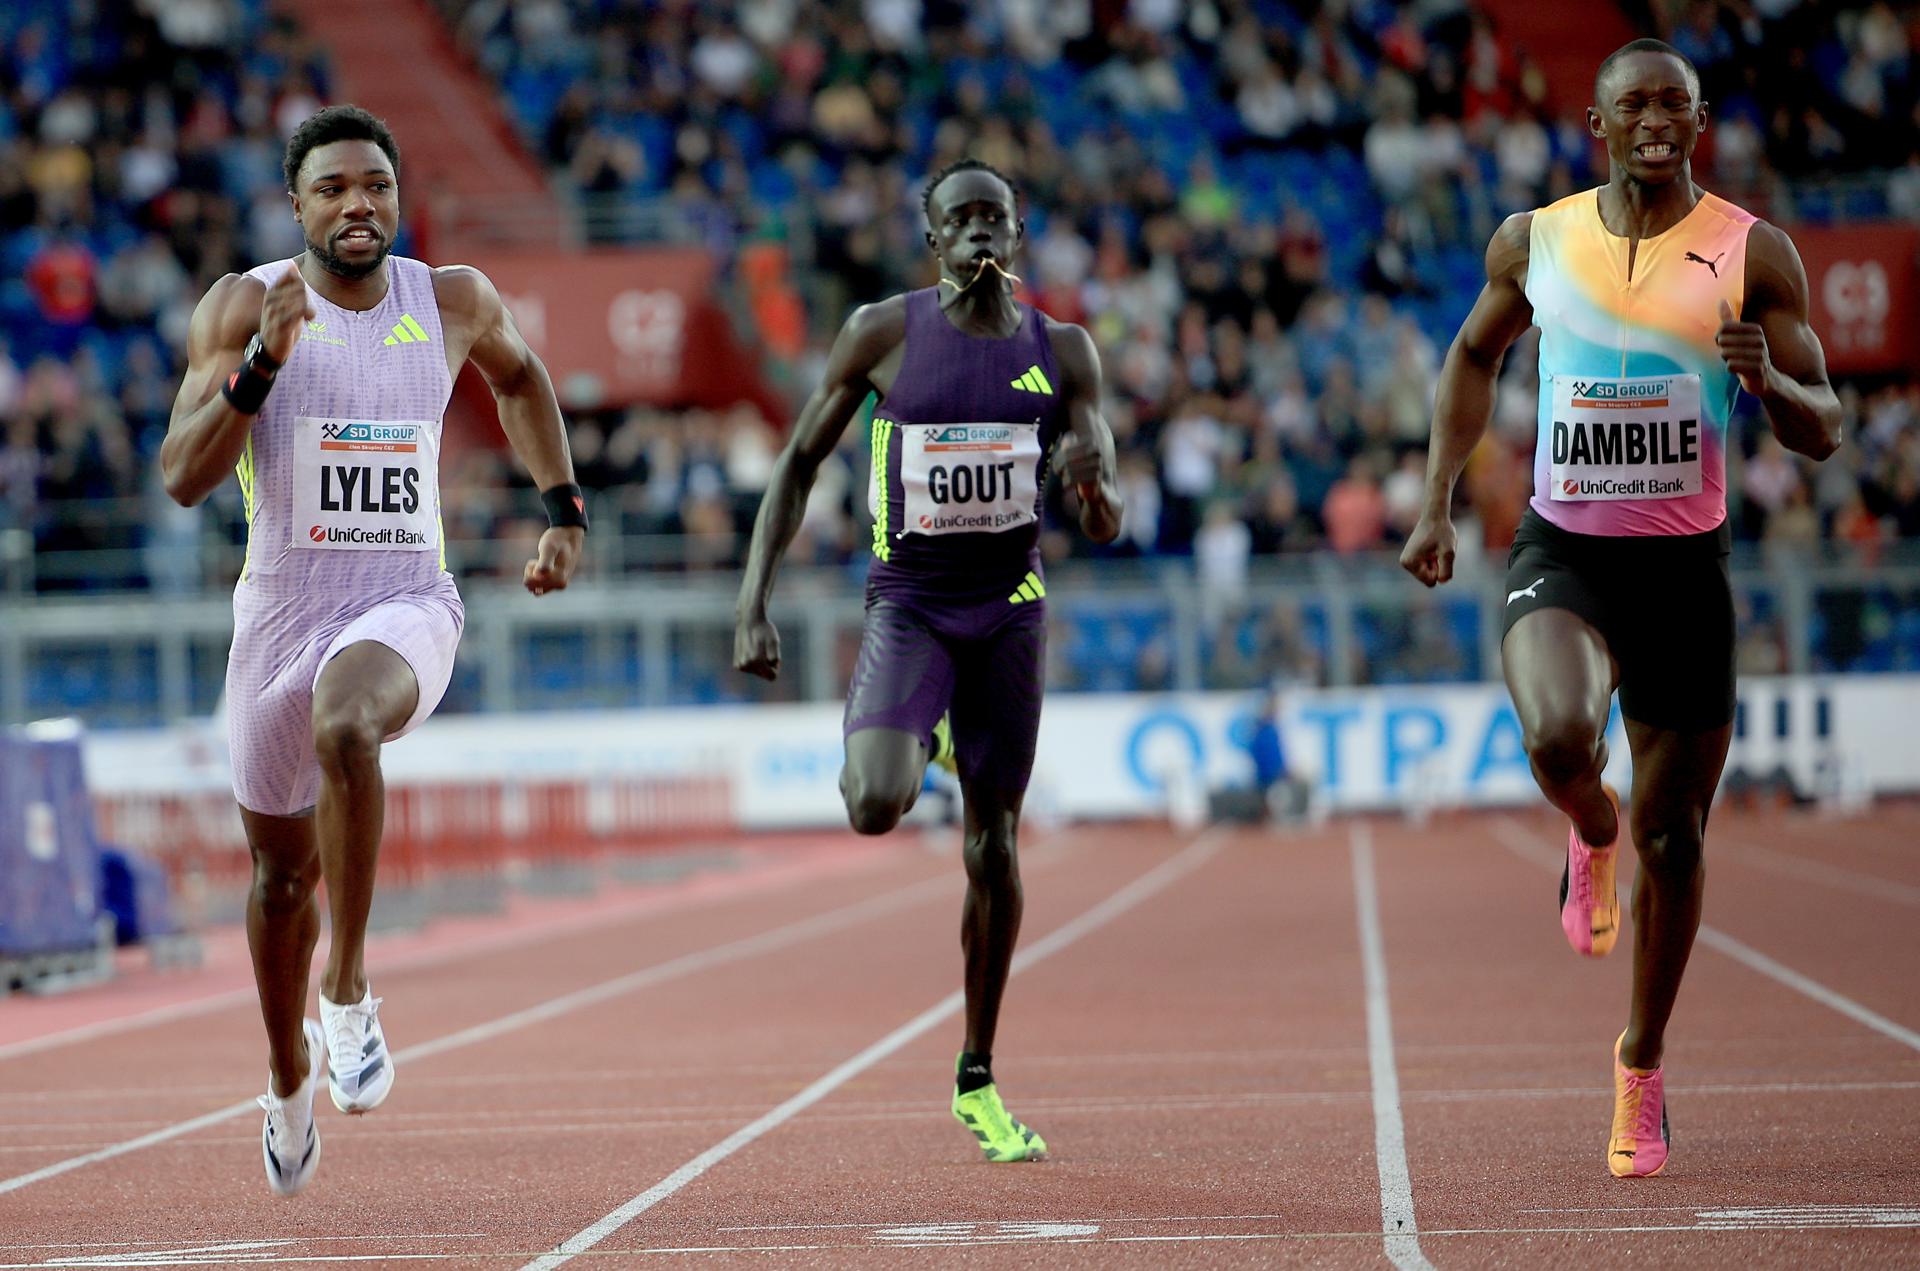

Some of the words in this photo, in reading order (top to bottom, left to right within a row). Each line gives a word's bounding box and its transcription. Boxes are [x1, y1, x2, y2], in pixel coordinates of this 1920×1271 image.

[1596, 385, 1614, 396] SD
[1620, 384, 1664, 397] GROUP
[349, 427, 368, 438] SD
[373, 428, 415, 439] GROUP
[947, 429, 966, 440] SD
[970, 429, 1009, 439] GROUP
[1552, 419, 1697, 465] DAMBILE
[320, 465, 419, 514] LYLES
[928, 462, 1014, 504] GOUT
[1581, 479, 1645, 495] UniCredit
[1649, 478, 1684, 494] Bank
[934, 514, 992, 529] UniCredit
[995, 510, 1022, 527] Bank
[327, 527, 392, 543] UniCredit
[395, 528, 426, 544] Bank
